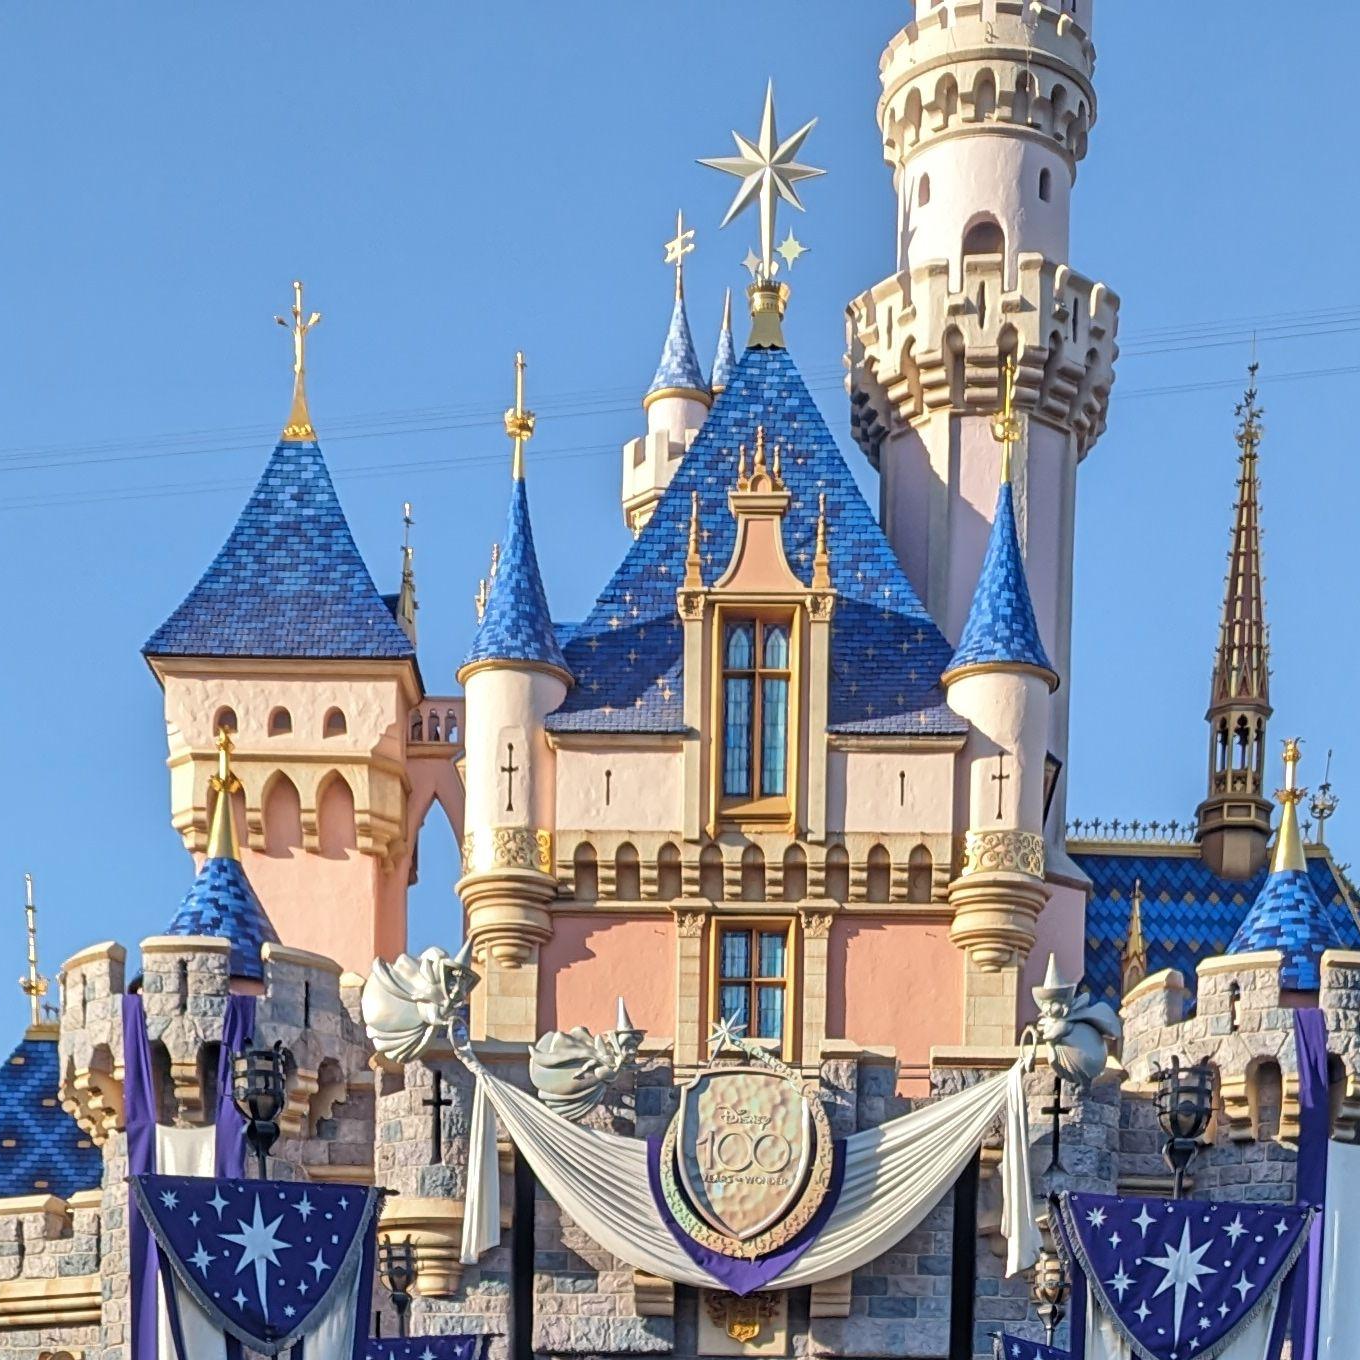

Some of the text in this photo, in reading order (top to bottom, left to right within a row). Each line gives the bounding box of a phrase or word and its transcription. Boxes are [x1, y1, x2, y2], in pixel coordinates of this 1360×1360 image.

[696, 1130, 793, 1174] 100
[704, 1174, 734, 1185] YEARS
[744, 1175, 790, 1187] WONDER
